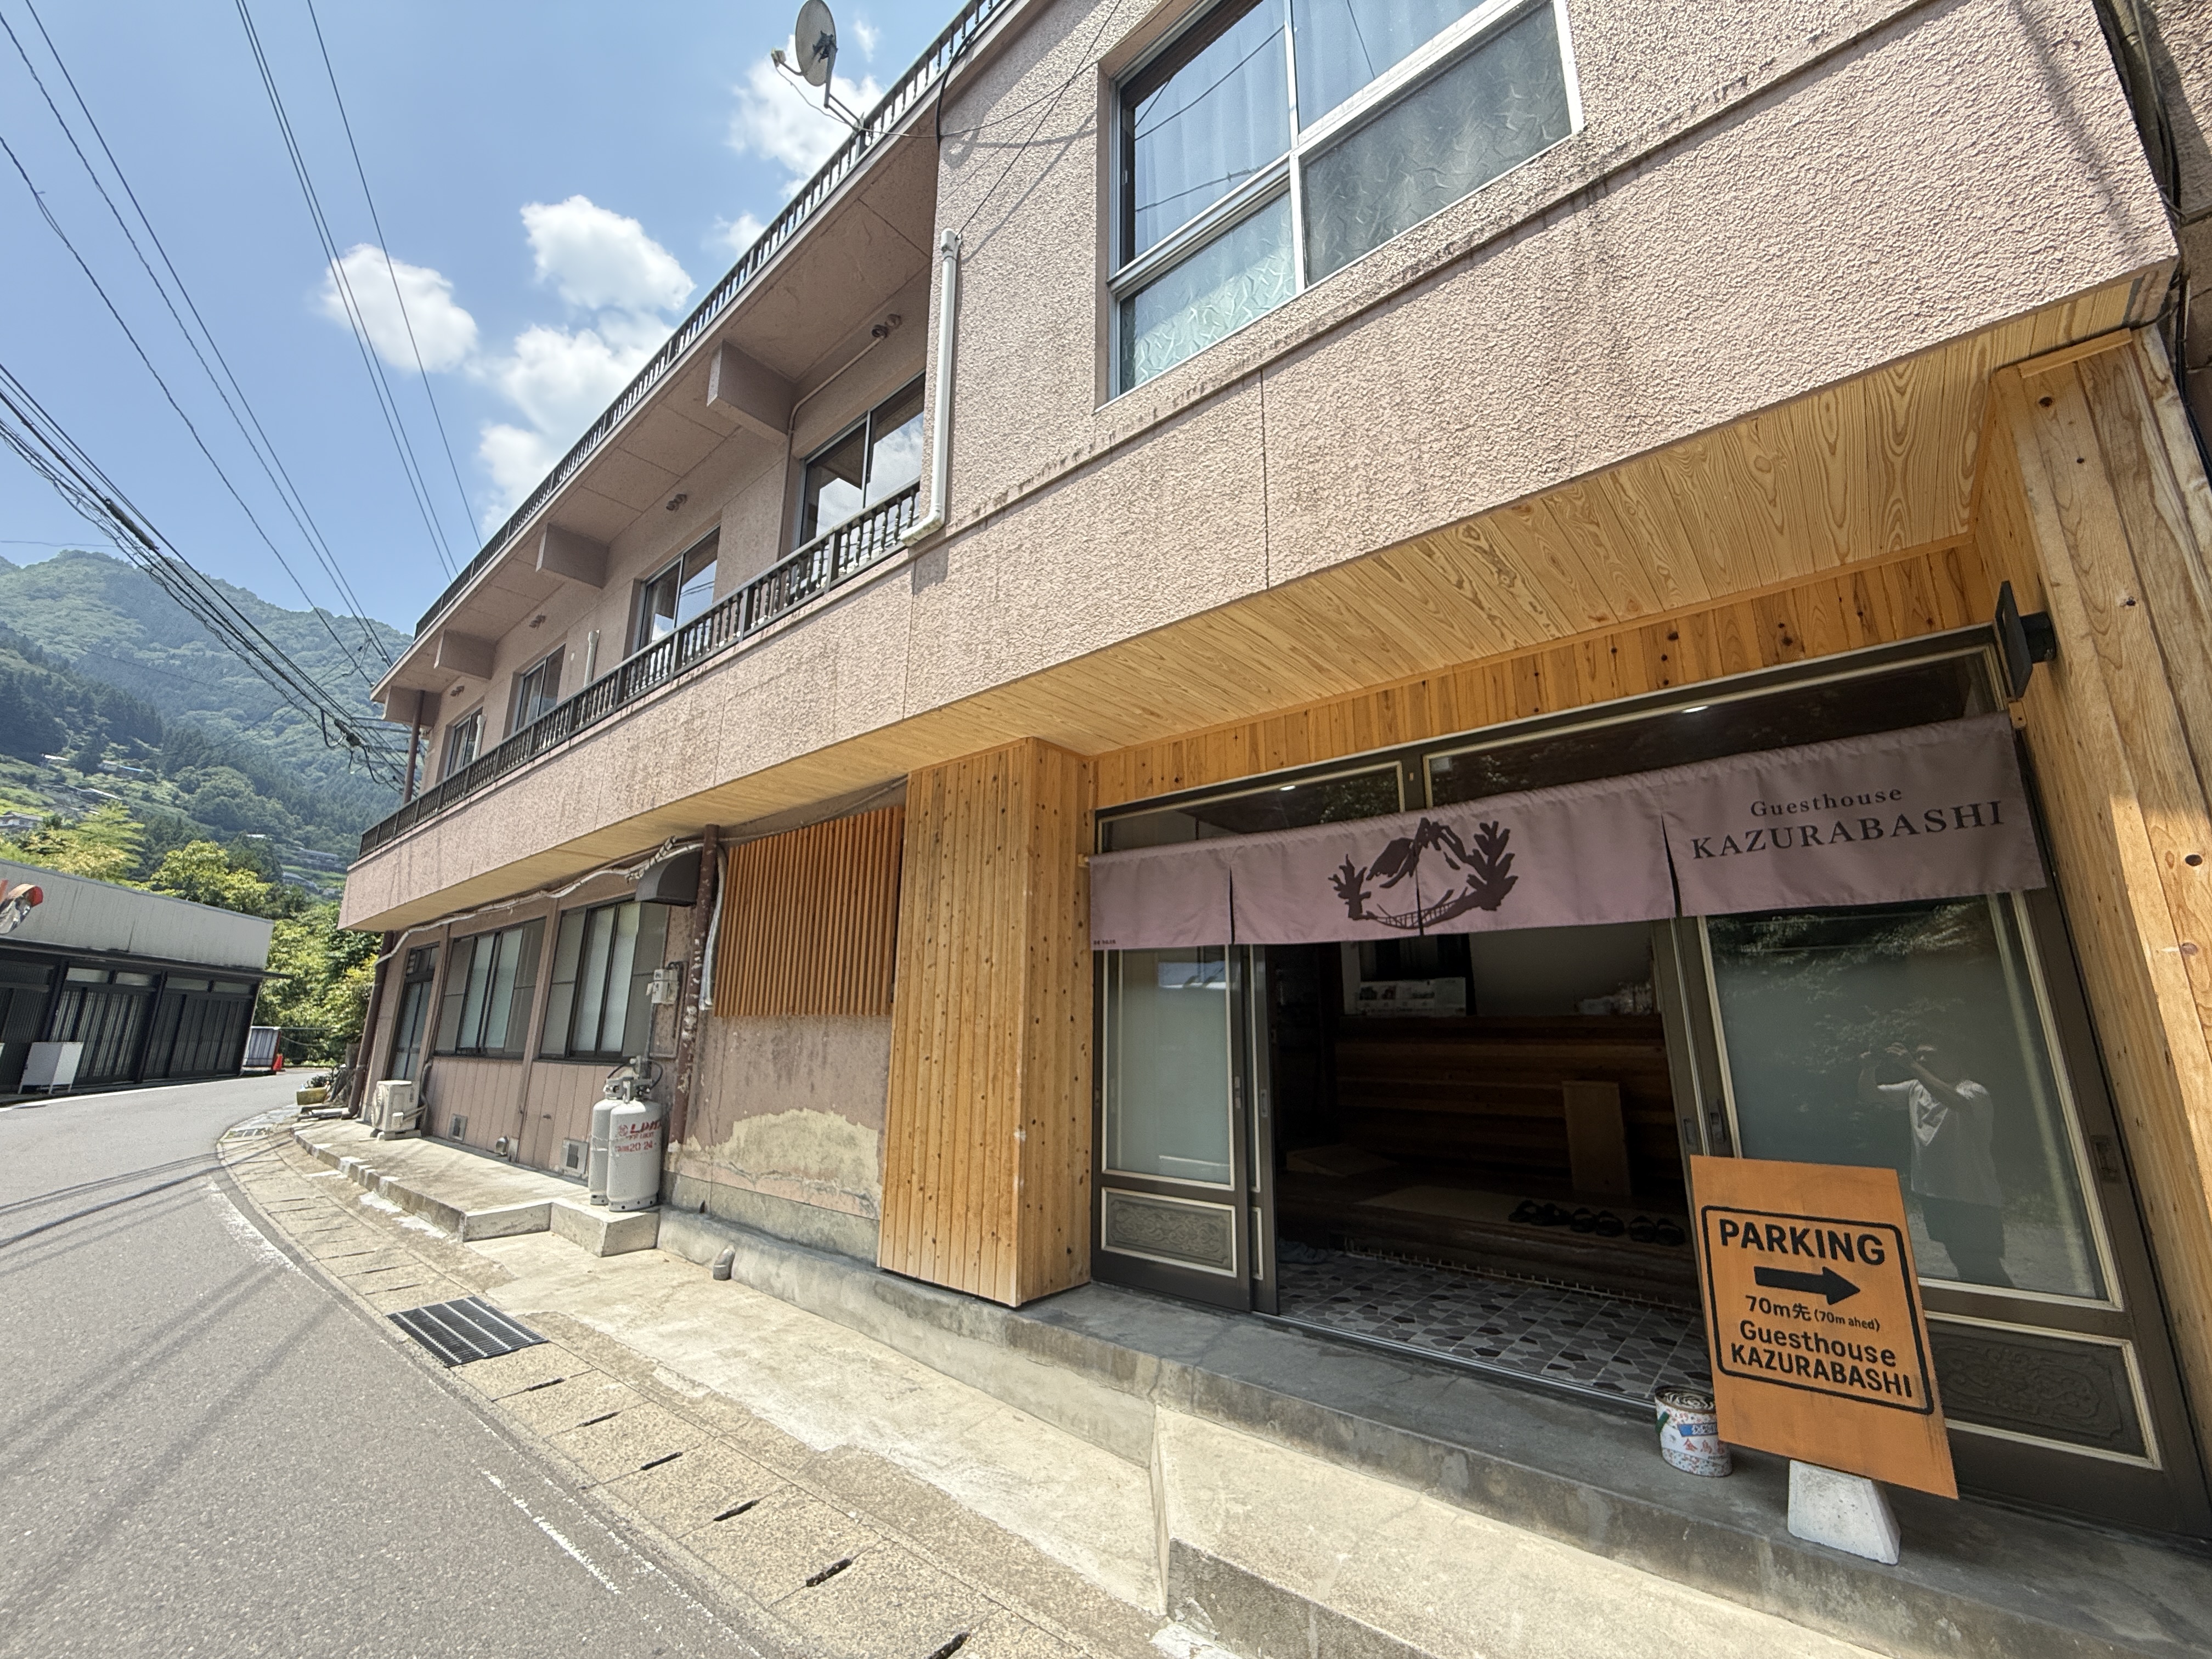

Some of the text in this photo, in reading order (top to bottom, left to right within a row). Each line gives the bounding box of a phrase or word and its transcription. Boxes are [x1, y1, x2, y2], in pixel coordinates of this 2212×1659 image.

[1750, 789, 1903, 817] Guesthouse
[1692, 800, 2005, 860] KAZURABASHI
[1719, 1218, 1885, 1266] PARKING
[1745, 1295, 1881, 1333] 70m先 (70m ahed)
[1740, 1319, 1896, 1367] Guesthouse
[1730, 1342, 1912, 1398] KAZURABASHI
